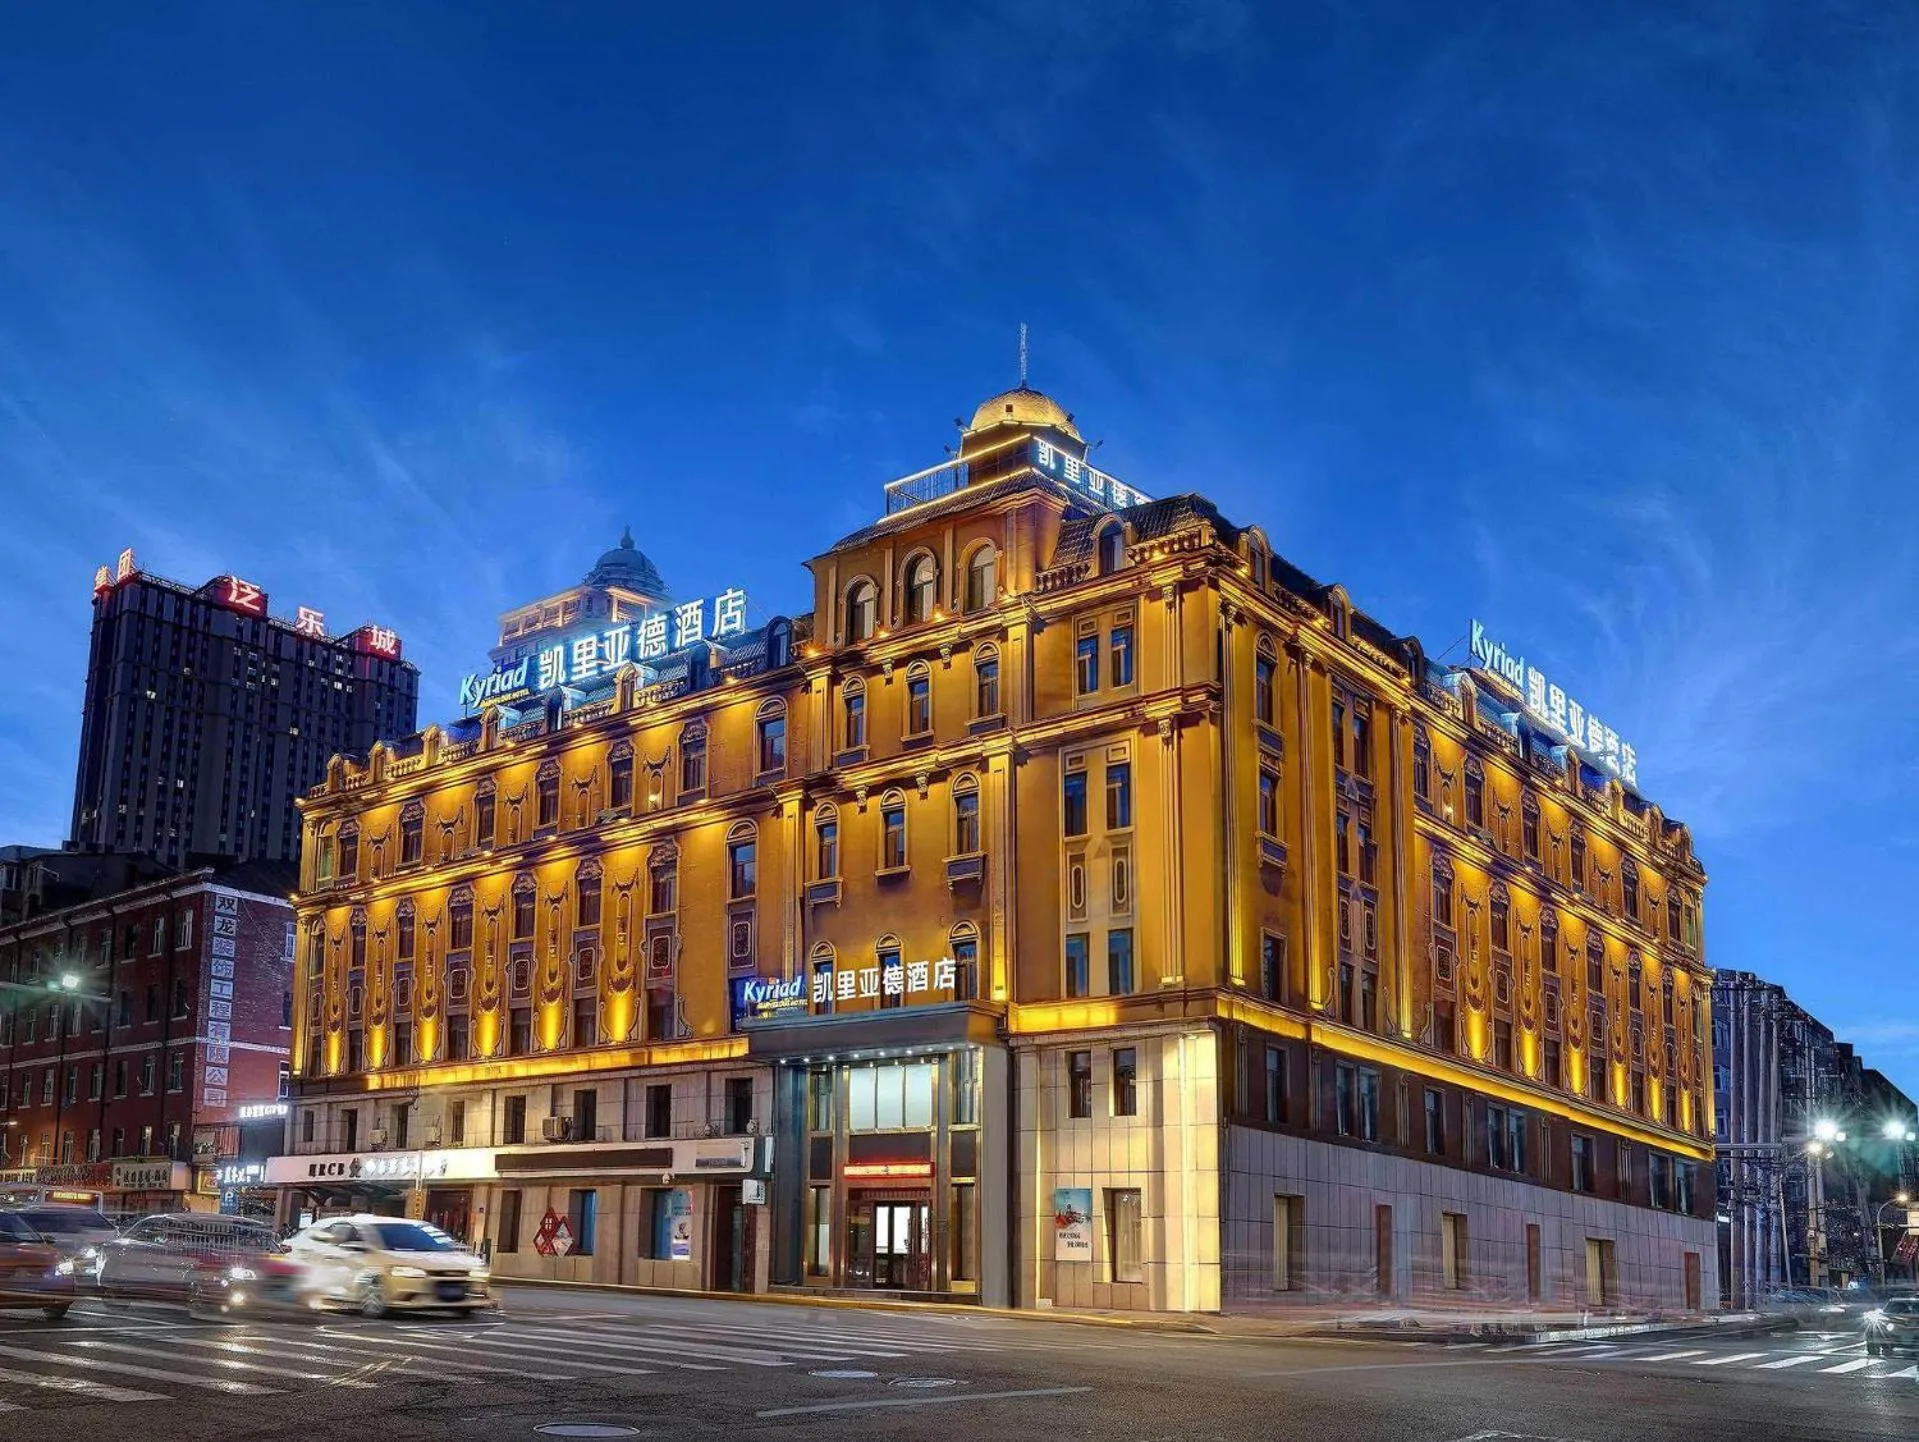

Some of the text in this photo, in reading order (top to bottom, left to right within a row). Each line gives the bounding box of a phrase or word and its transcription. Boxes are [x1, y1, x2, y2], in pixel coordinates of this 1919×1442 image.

[228, 575, 396, 655] 泛乐城
[459, 588, 748, 708] Kyriad 凯里亚德酒店
[1471, 618, 1525, 688] Kyriad
[203, 895, 238, 1107] 双龙装饰工程有限公司
[743, 957, 957, 1004] Kyriad 凯里亚德酒店
